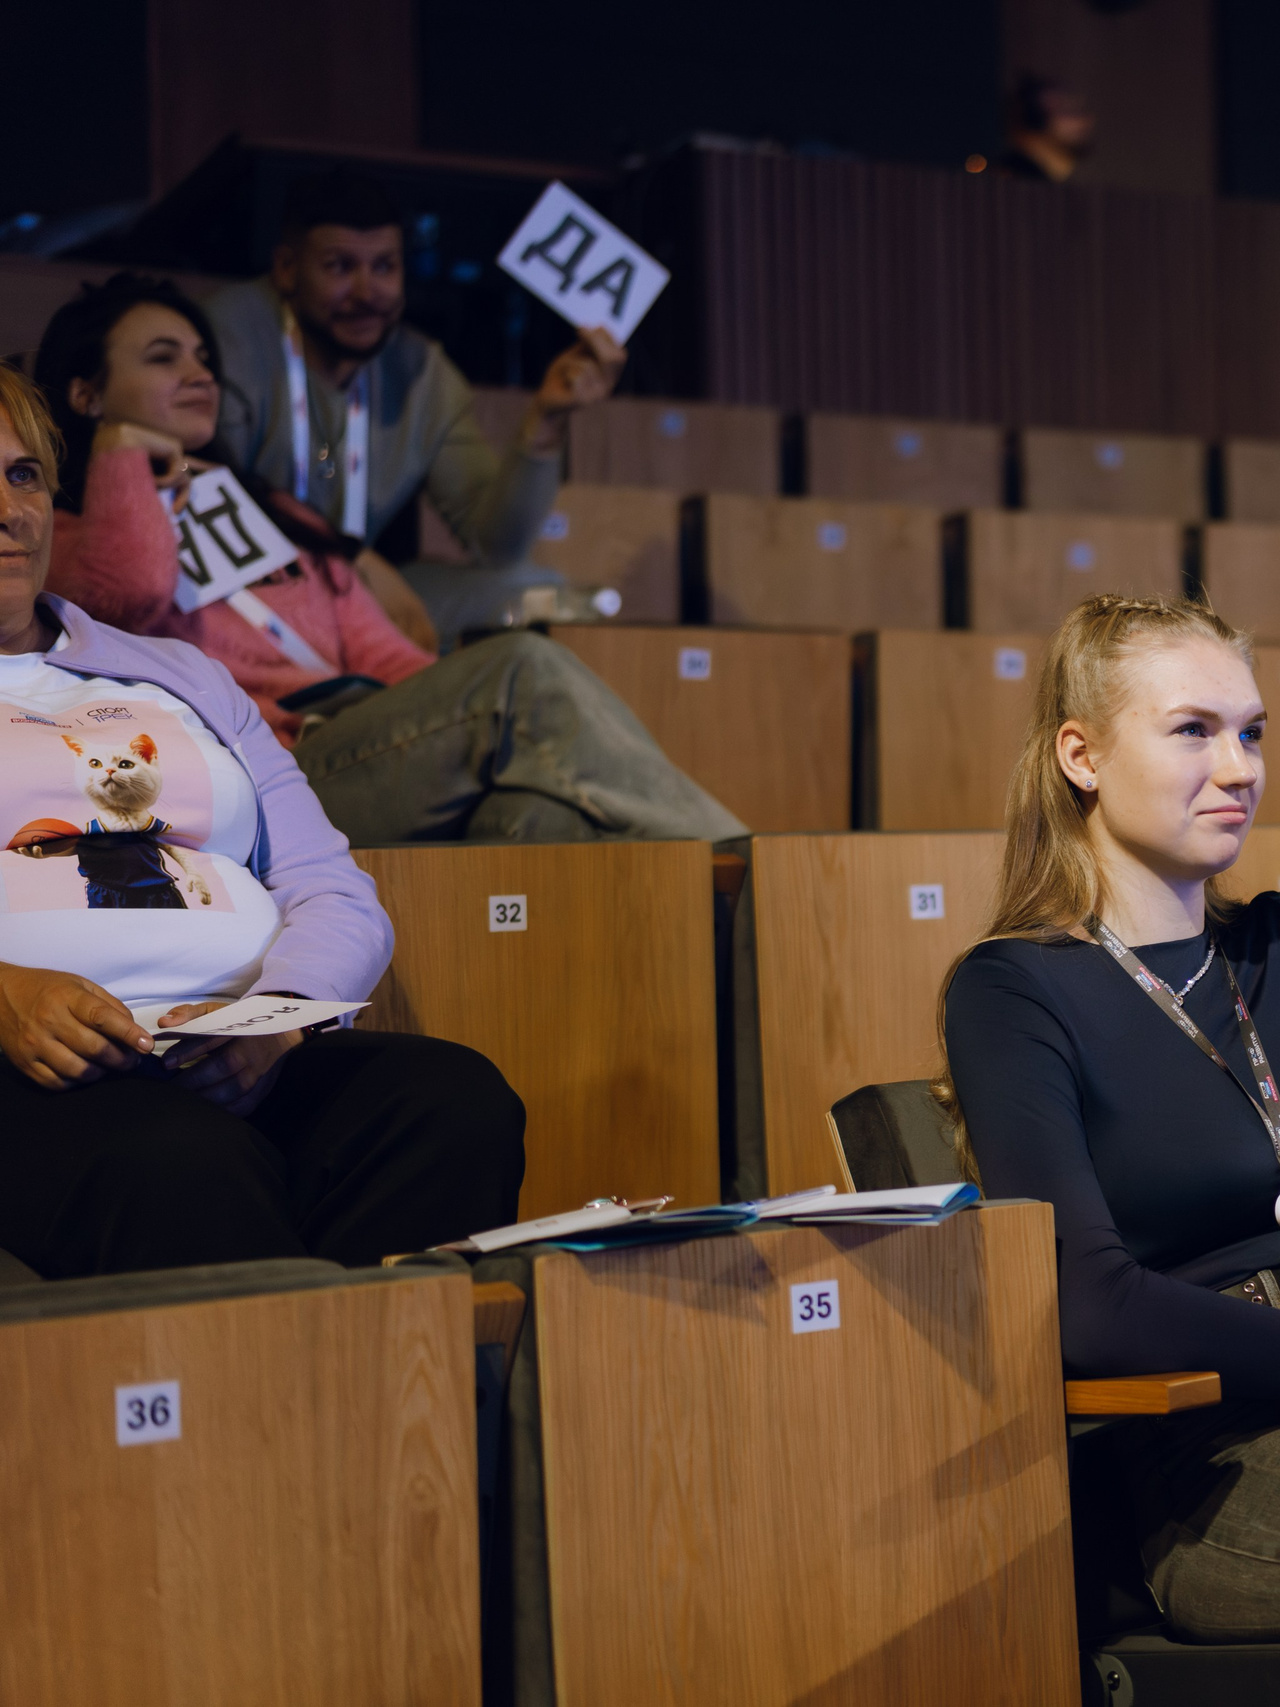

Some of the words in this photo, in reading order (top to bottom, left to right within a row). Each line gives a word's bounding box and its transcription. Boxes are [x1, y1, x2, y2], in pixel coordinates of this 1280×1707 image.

[519, 213, 636, 318] ДА
[87, 707, 129, 717] СПОРТ
[496, 903, 521, 923] 32
[918, 893, 936, 911] 31
[799, 1292, 832, 1321] 35
[126, 1394, 171, 1431] 36
